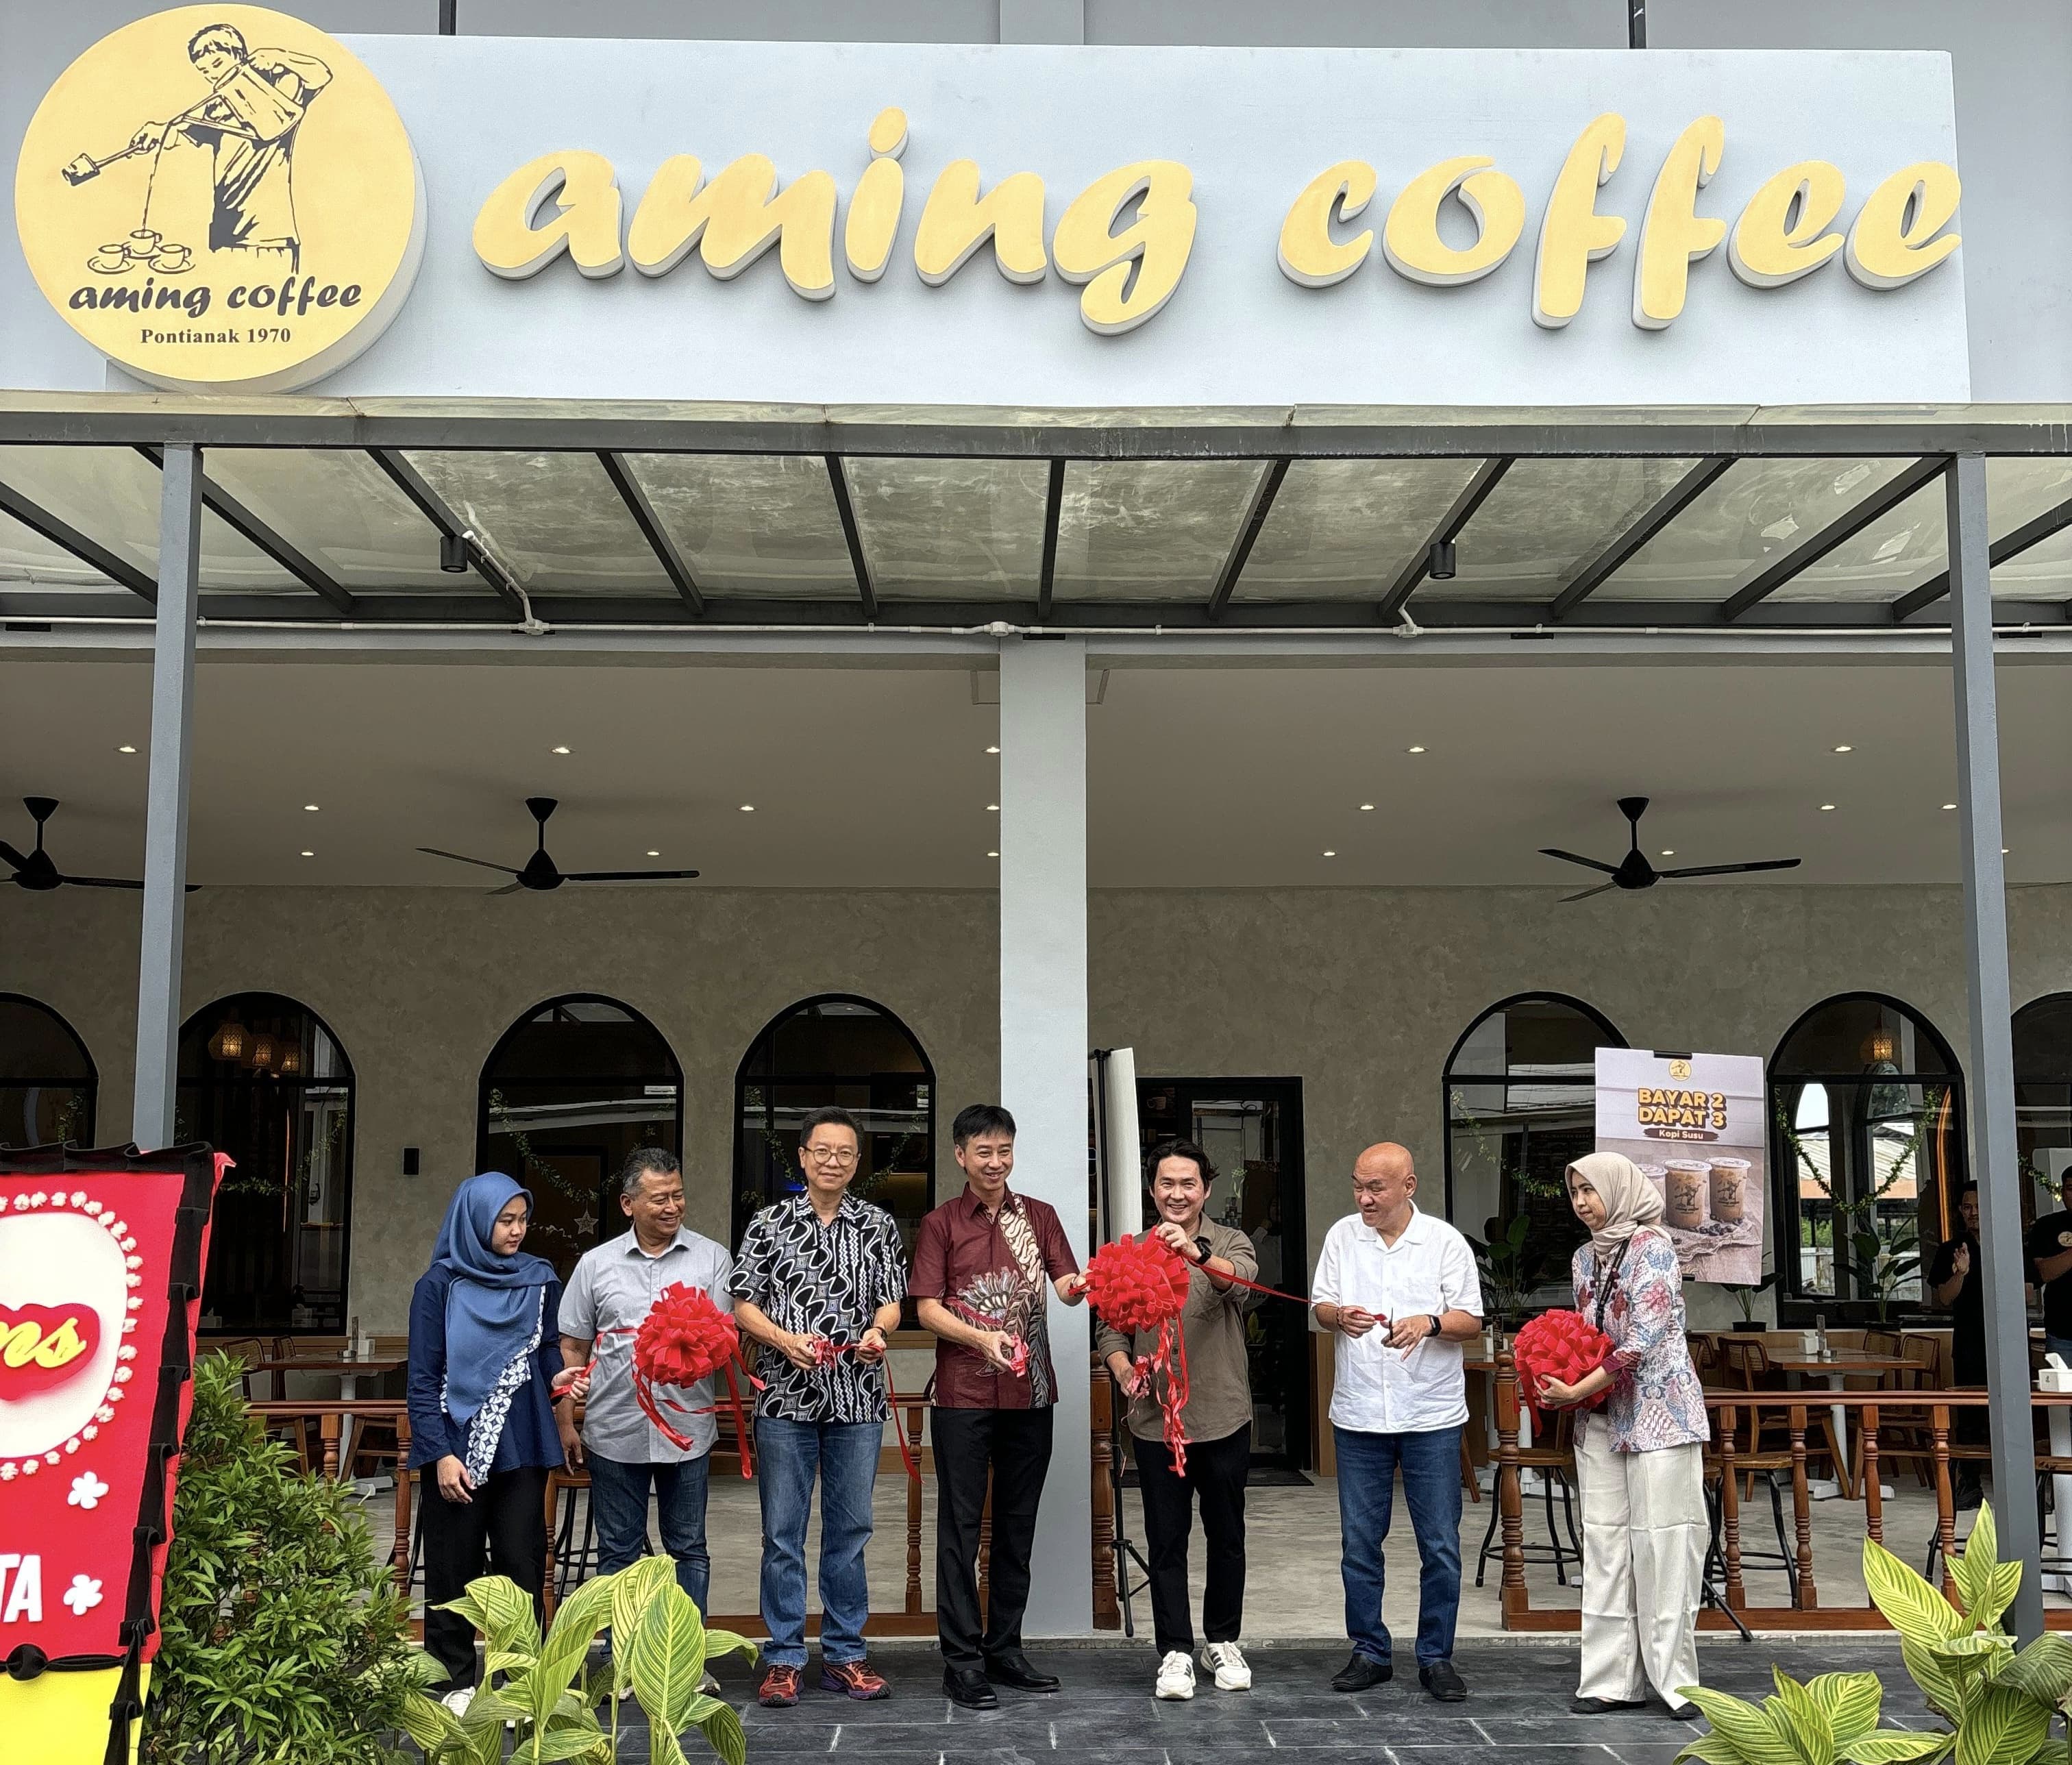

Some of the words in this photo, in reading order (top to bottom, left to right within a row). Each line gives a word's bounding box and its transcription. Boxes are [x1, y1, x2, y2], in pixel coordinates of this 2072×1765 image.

[473, 108, 1197, 334] aming
[1277, 112, 1962, 329] coffee
[69, 277, 211, 318] aming
[227, 276, 362, 315] coffee
[140, 329, 240, 343] Pontianak
[247, 328, 291, 343] 1970
[1638, 1088, 1709, 1109] BAYAR
[1712, 1093, 1726, 1111] 2
[1638, 1107, 1709, 1128] DAPAT
[1712, 1111, 1727, 1129] 3
[1659, 1129, 1679, 1139] Kopi
[1681, 1131, 1703, 1139] Susu
